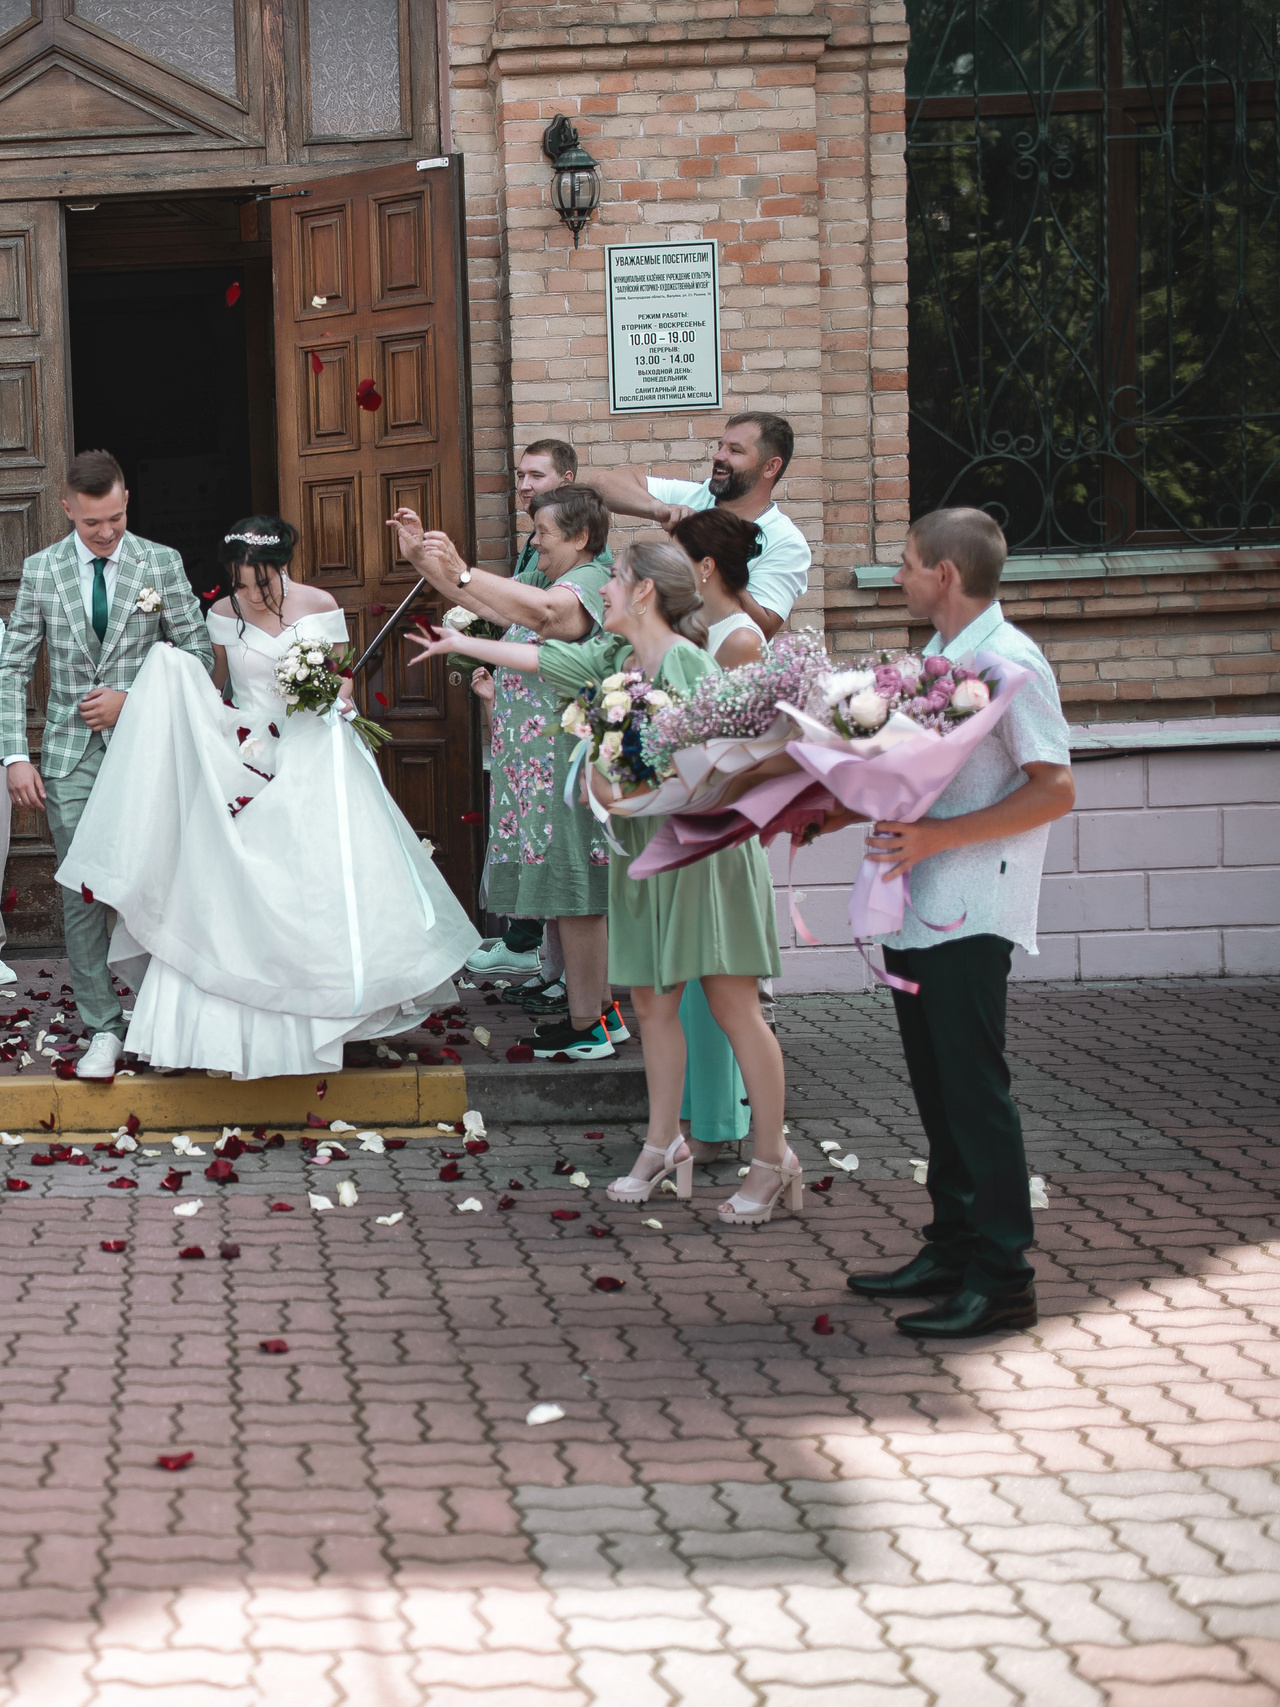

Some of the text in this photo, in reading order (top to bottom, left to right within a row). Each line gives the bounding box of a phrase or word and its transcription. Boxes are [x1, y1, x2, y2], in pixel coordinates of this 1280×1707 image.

[615, 252, 708, 266] УВАЖАЕМЫЕ ПОСЕТИТЕЛИ!
[614, 275, 646, 283] МУНИЦИПАЛЬНОЕ
[666, 272, 690, 281] УЧРЕЖДЕНИЕ
[640, 281, 694, 292] ИСТОРИКО-ХУДОЖЕСТВЕННЫЙ
[659, 321, 706, 329] ВОСКРЕСЕНЬЕ
[630, 333, 657, 345] 10.00
[668, 331, 695, 343] 19.00
[635, 356, 660, 365] 13.00
[670, 353, 695, 363] 14.00
[643, 375, 688, 383] ПОНЕДЕЛЬНИК
[635, 386, 676, 394] САНИТАРНЫЙ
